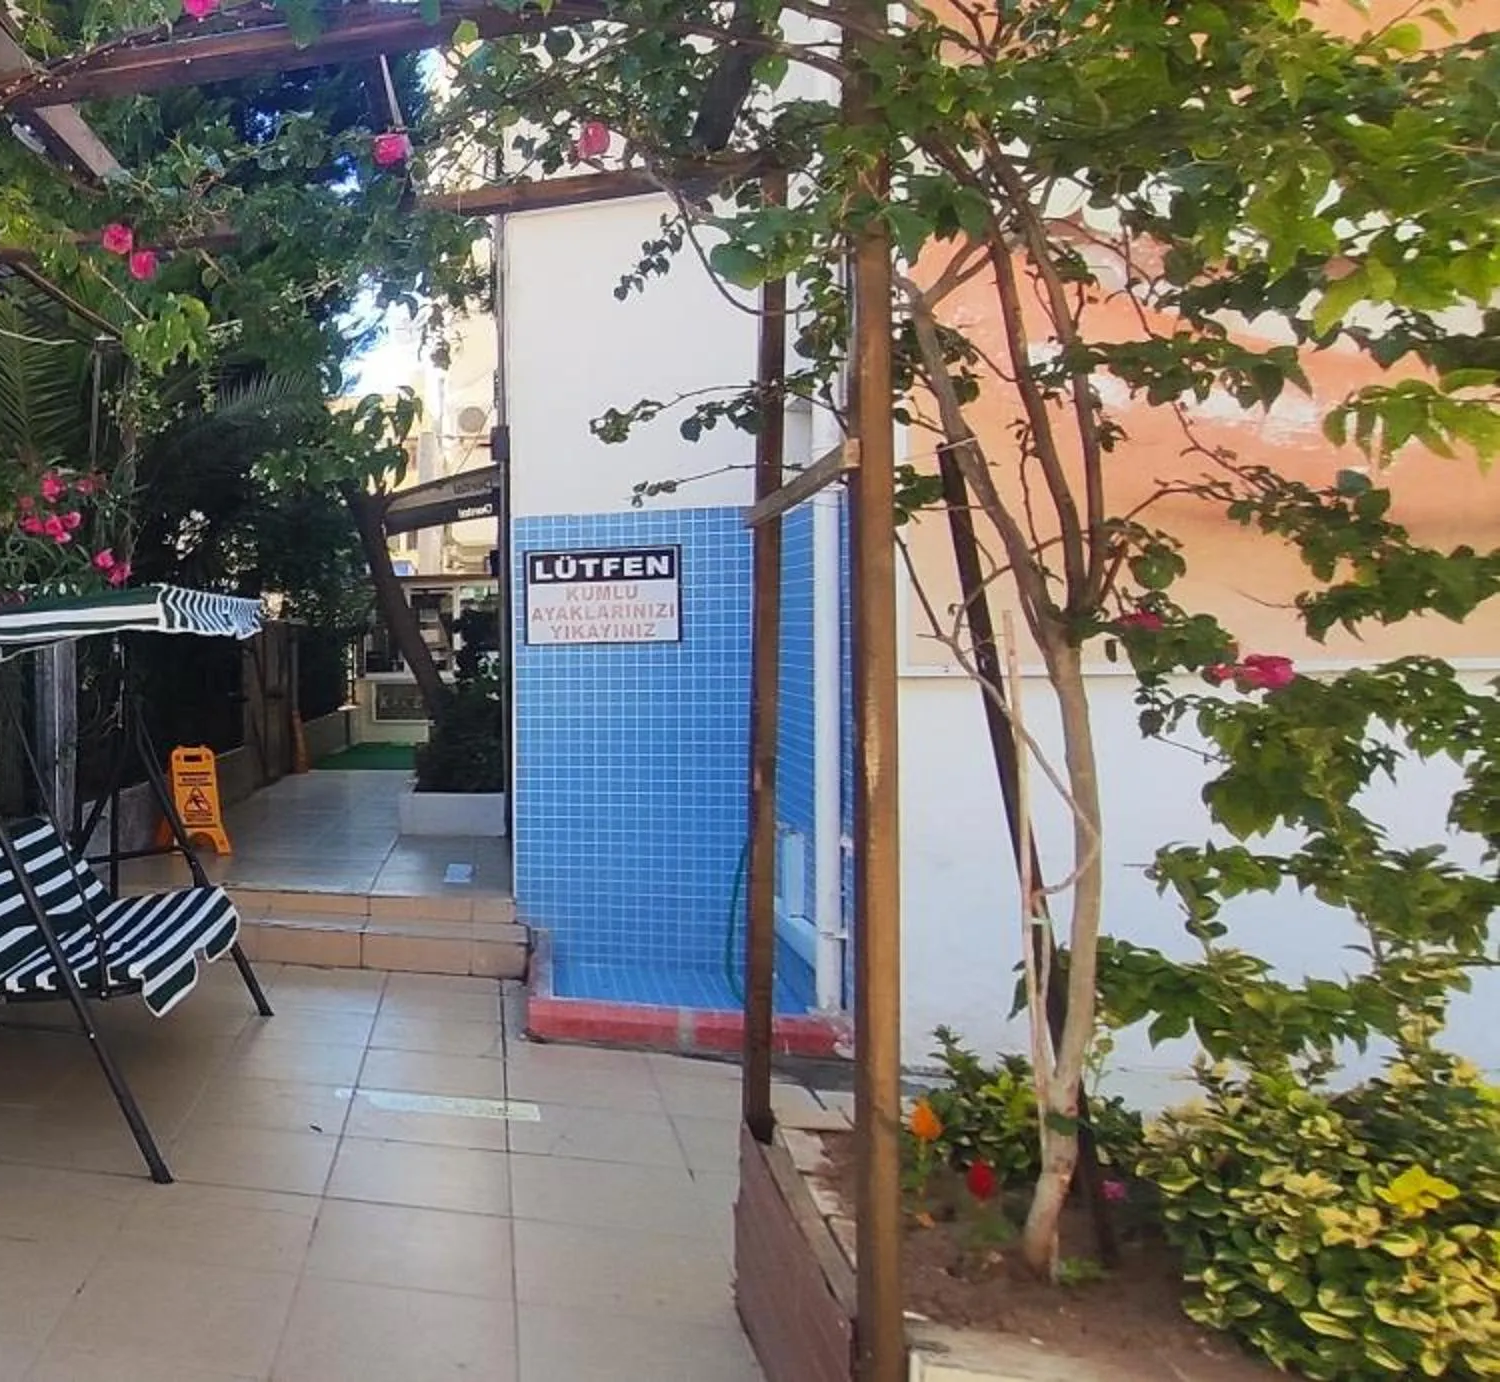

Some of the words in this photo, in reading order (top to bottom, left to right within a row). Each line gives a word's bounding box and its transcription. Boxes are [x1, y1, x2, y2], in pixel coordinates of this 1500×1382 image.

[535, 556, 669, 580] LÜTFEN
[565, 585, 638, 600] KUMLU
[531, 604, 675, 622] AYAKLARINIZI
[550, 623, 656, 639] YIKAYINIZ
